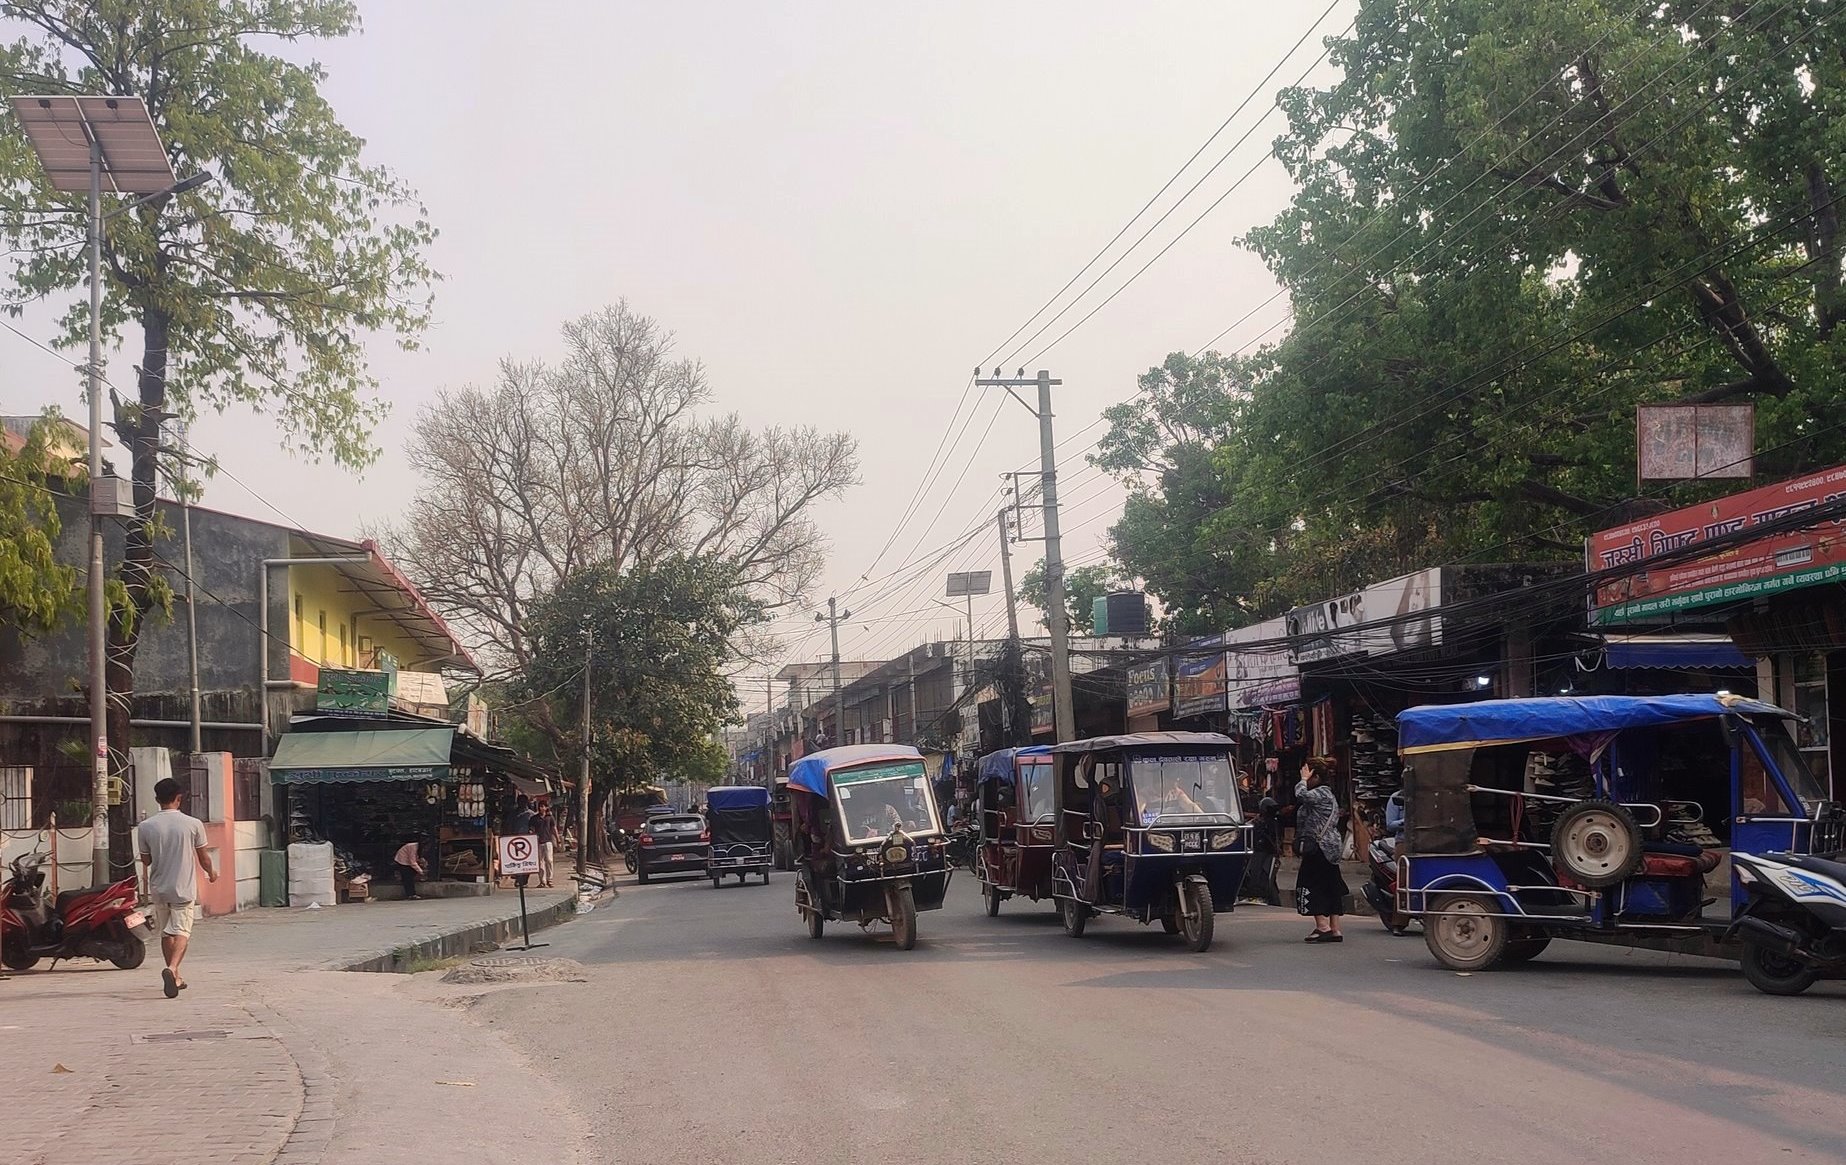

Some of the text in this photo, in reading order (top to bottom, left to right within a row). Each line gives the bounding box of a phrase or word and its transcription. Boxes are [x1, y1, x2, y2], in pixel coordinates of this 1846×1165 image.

[1704, 589, 1723, 602] पुरानो
[1724, 582, 1763, 598] हारमोनियम
[1128, 667, 1156, 684] Focus
